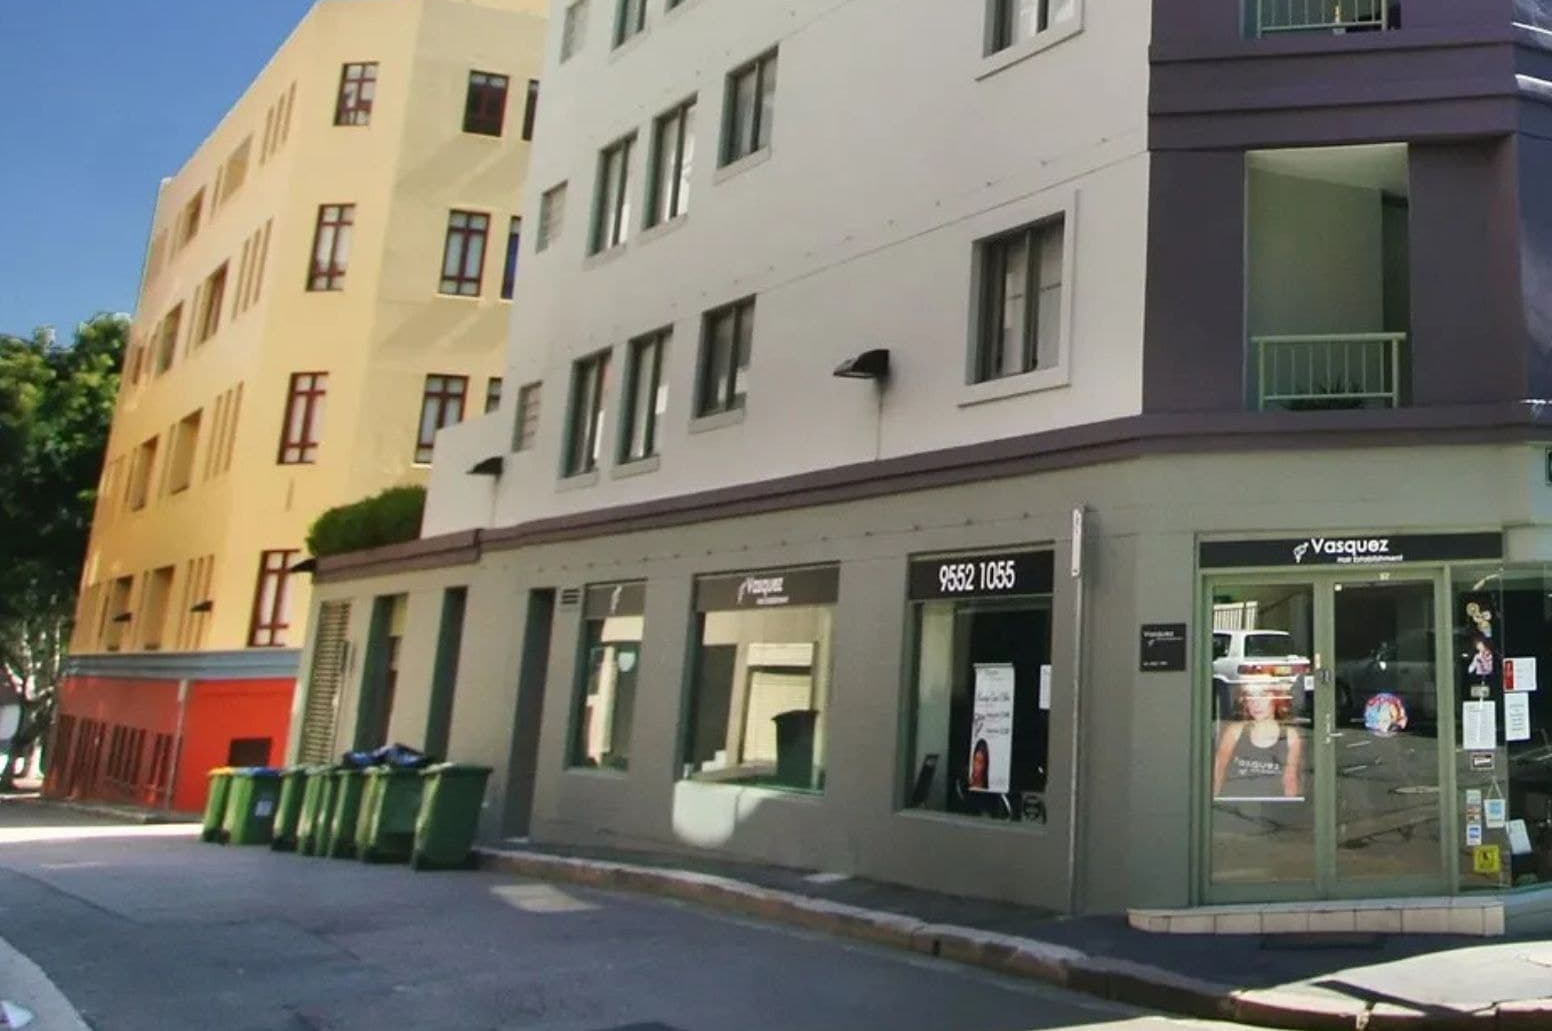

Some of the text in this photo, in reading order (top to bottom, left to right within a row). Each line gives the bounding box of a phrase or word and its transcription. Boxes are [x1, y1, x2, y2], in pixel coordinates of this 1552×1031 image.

[1310, 537, 1389, 557] Vasquez
[939, 560, 1015, 592] 9552 1055
